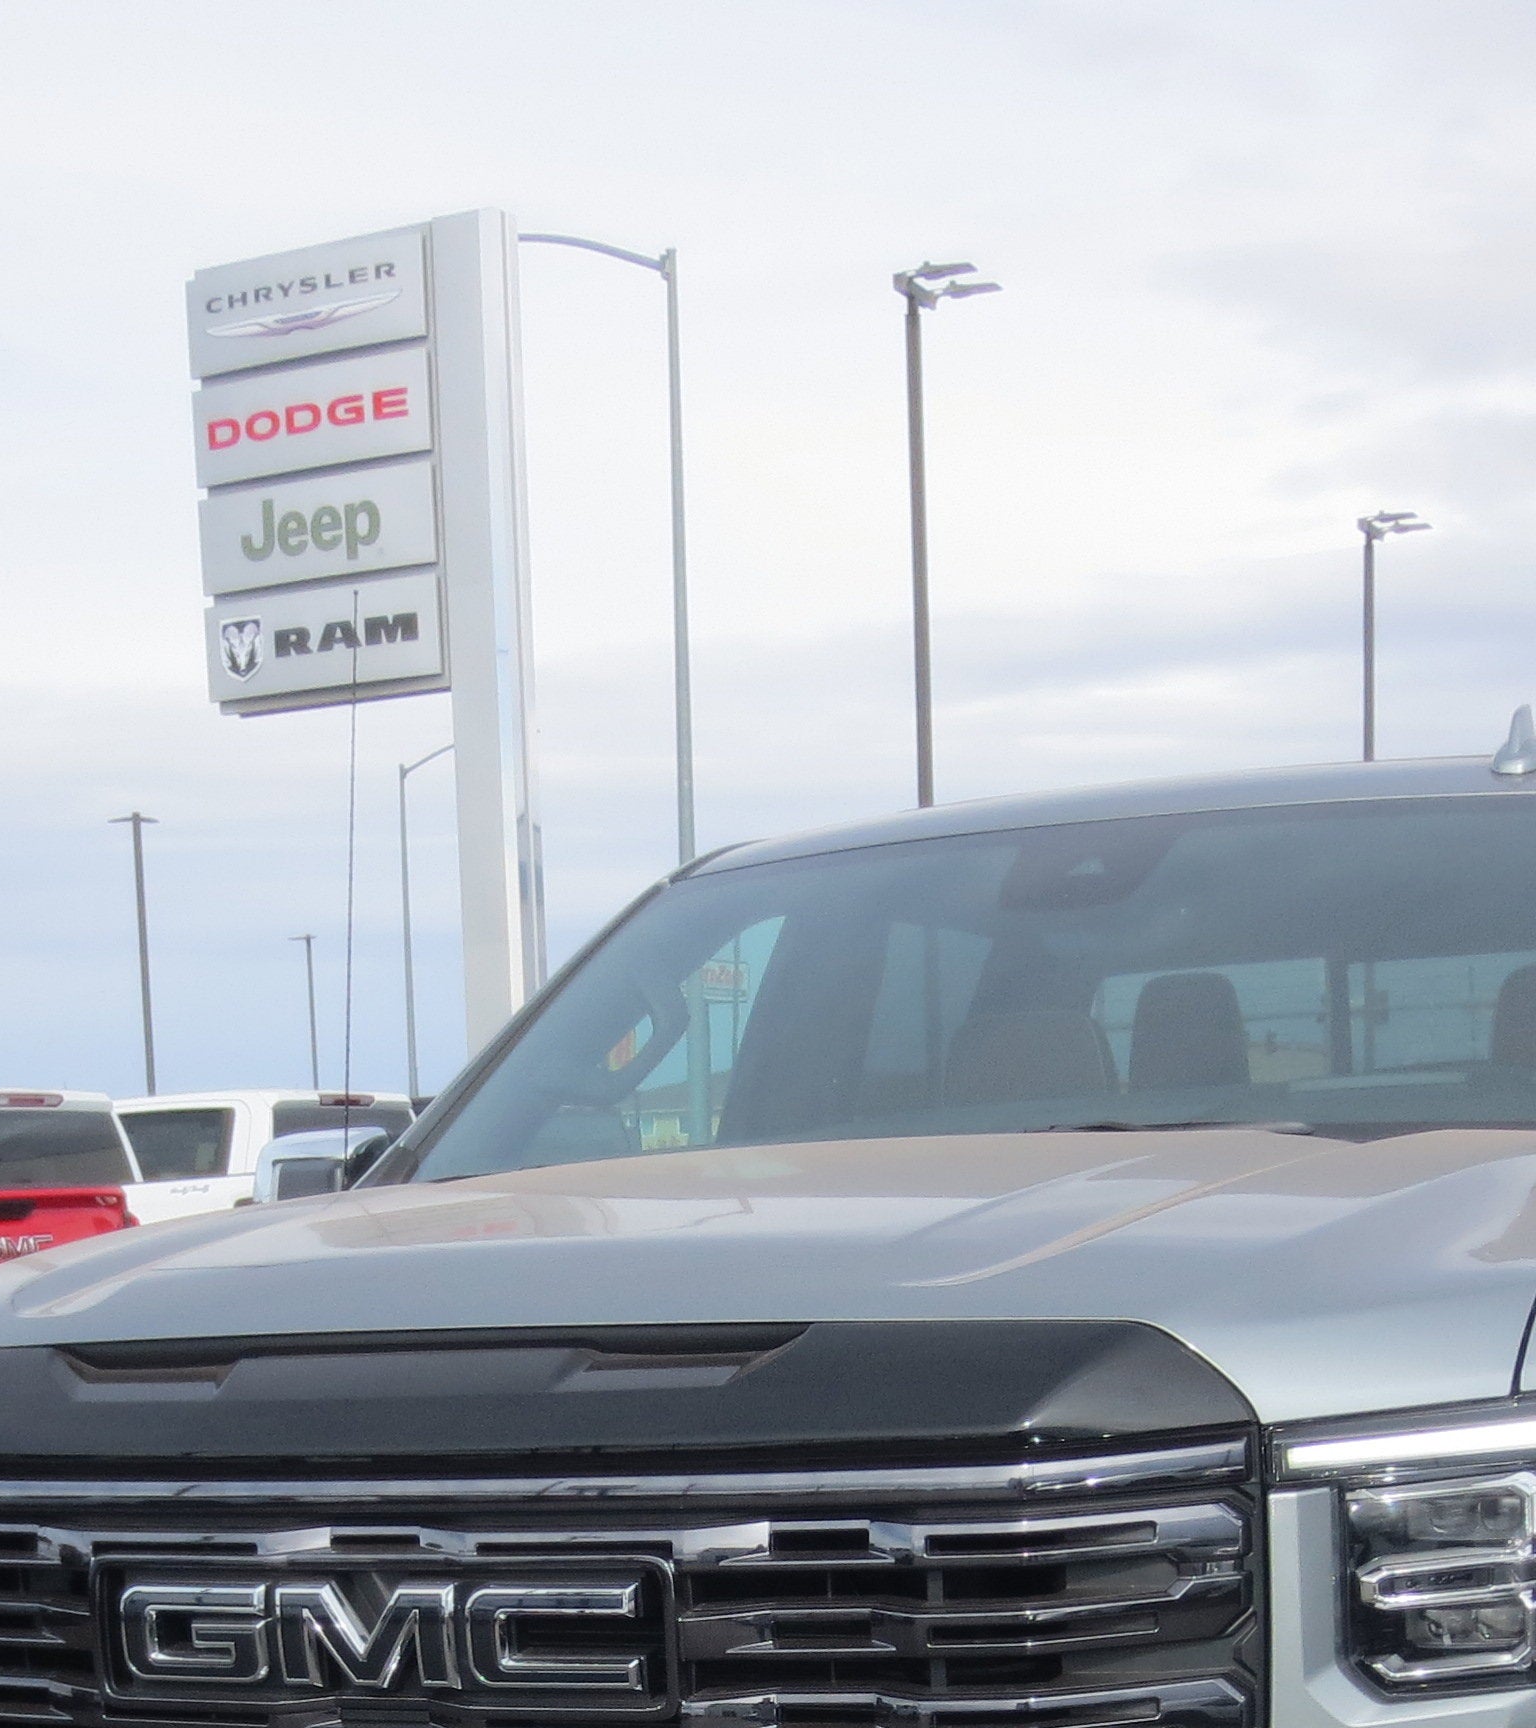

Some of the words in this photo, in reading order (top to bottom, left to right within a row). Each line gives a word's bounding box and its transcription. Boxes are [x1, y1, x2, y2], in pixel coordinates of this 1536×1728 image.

[205, 262, 396, 315] CHRYSLER
[207, 386, 410, 451] DODGE
[240, 498, 381, 562] Jeep
[274, 611, 419, 659] RAM
[120, 1581, 644, 1691] GMC
